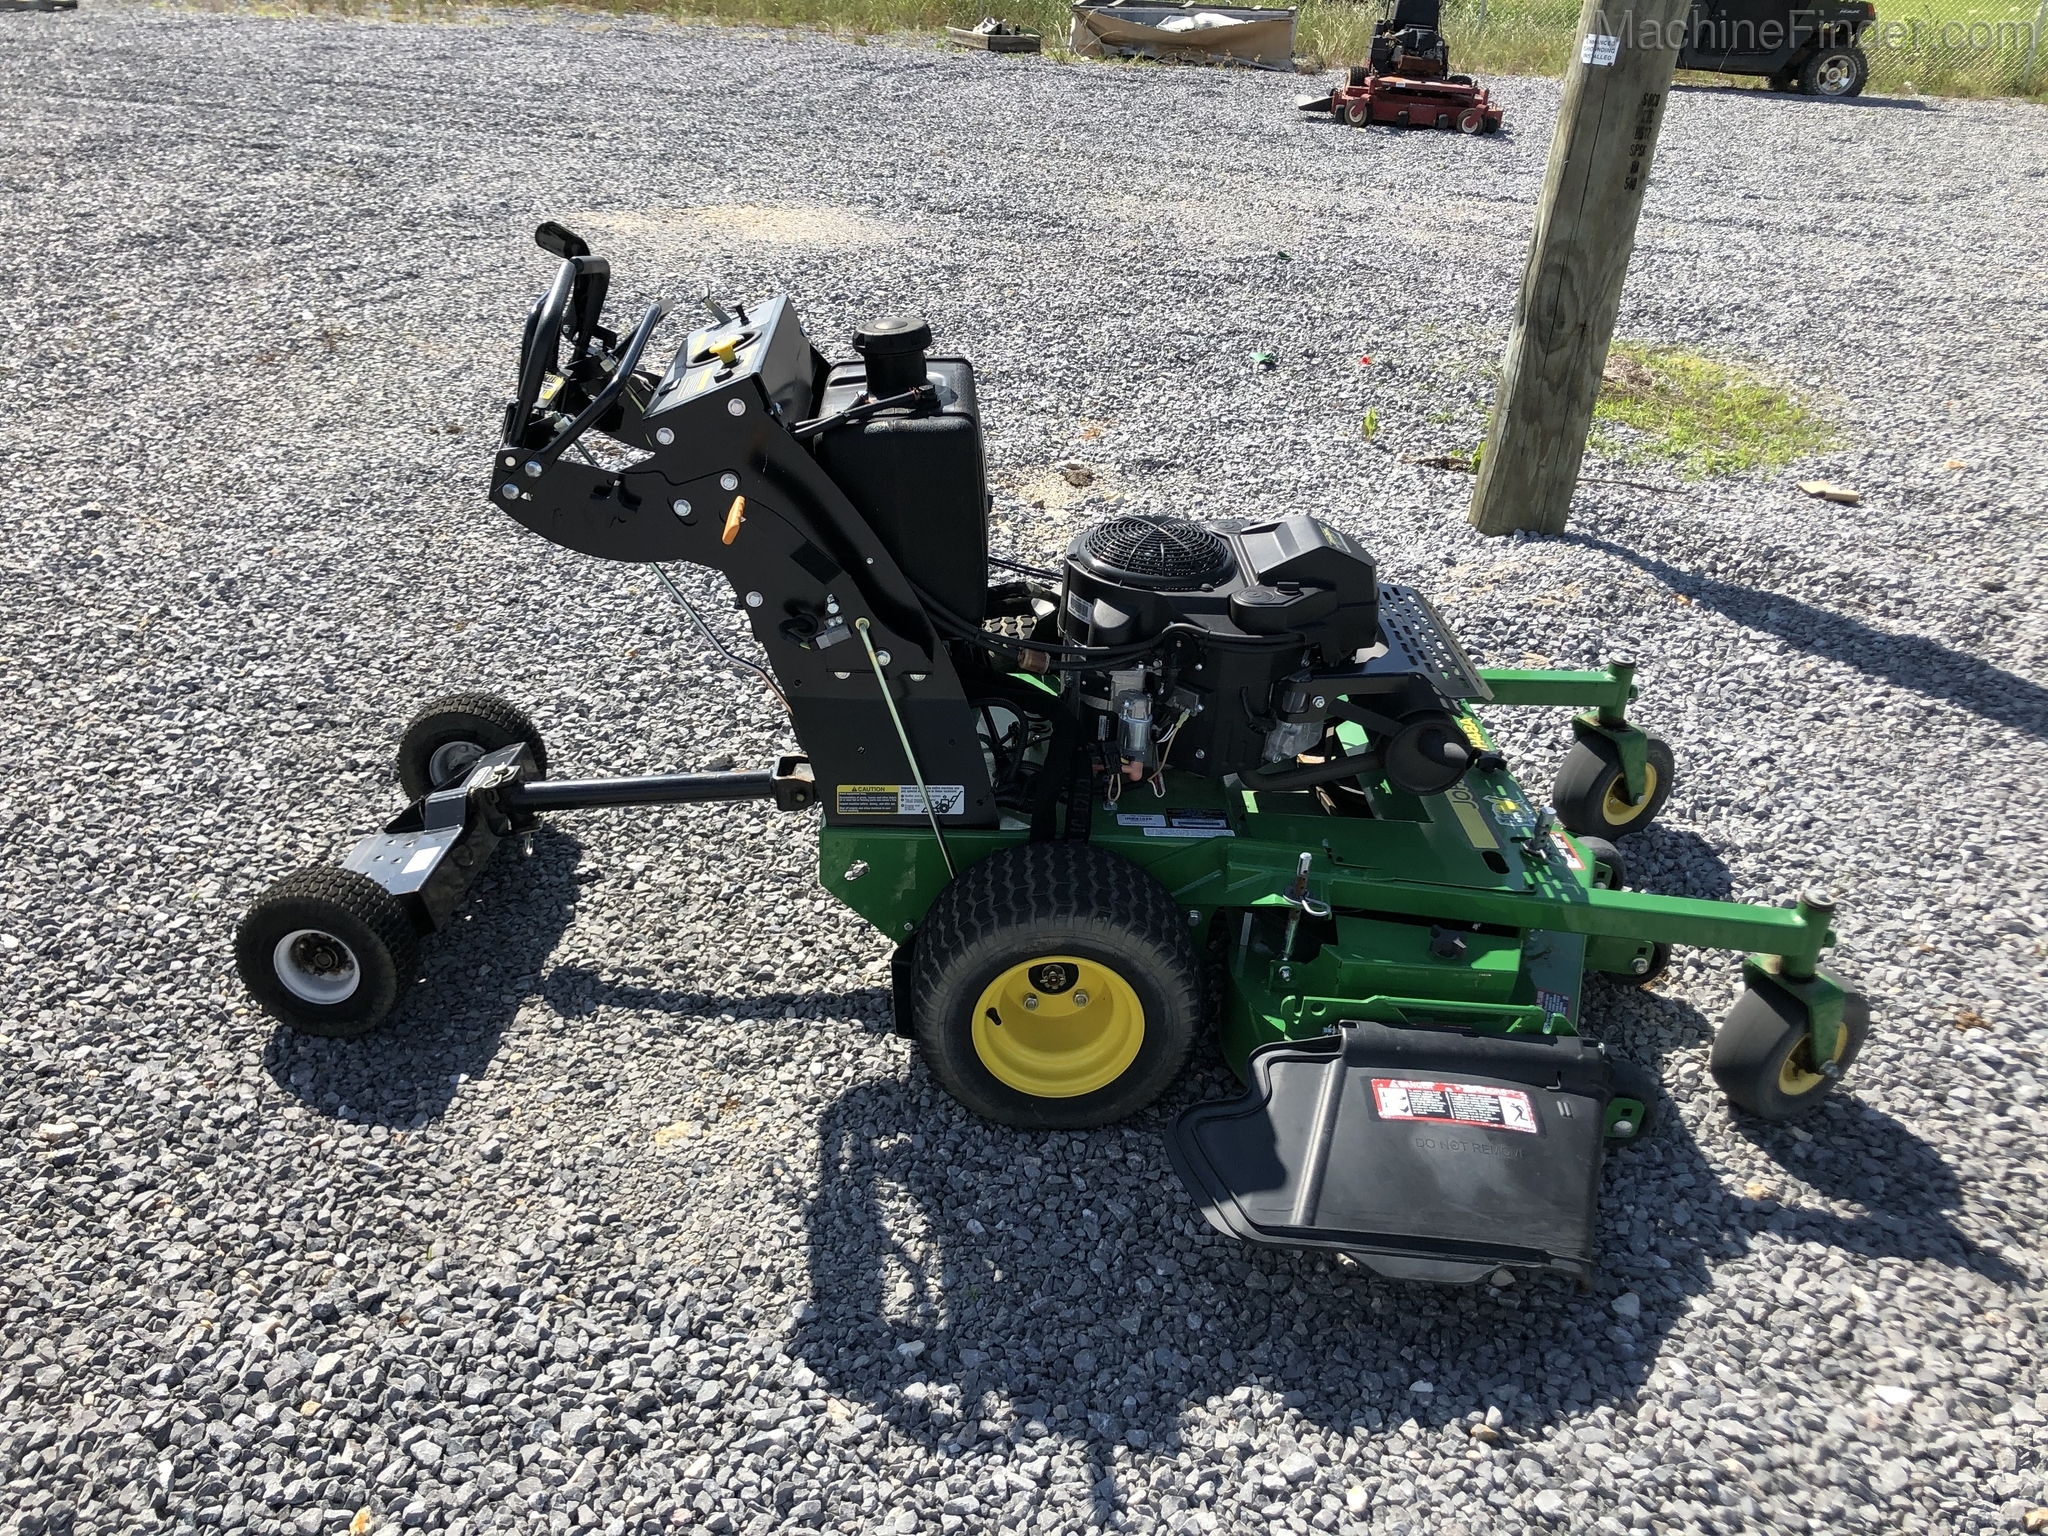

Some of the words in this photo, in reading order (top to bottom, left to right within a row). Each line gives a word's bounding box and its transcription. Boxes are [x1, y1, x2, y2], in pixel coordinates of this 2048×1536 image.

[1583, 46, 1616, 54] GRONDING
[1415, 1138, 1436, 1149] DO
[1440, 1140, 1468, 1152] NOT
